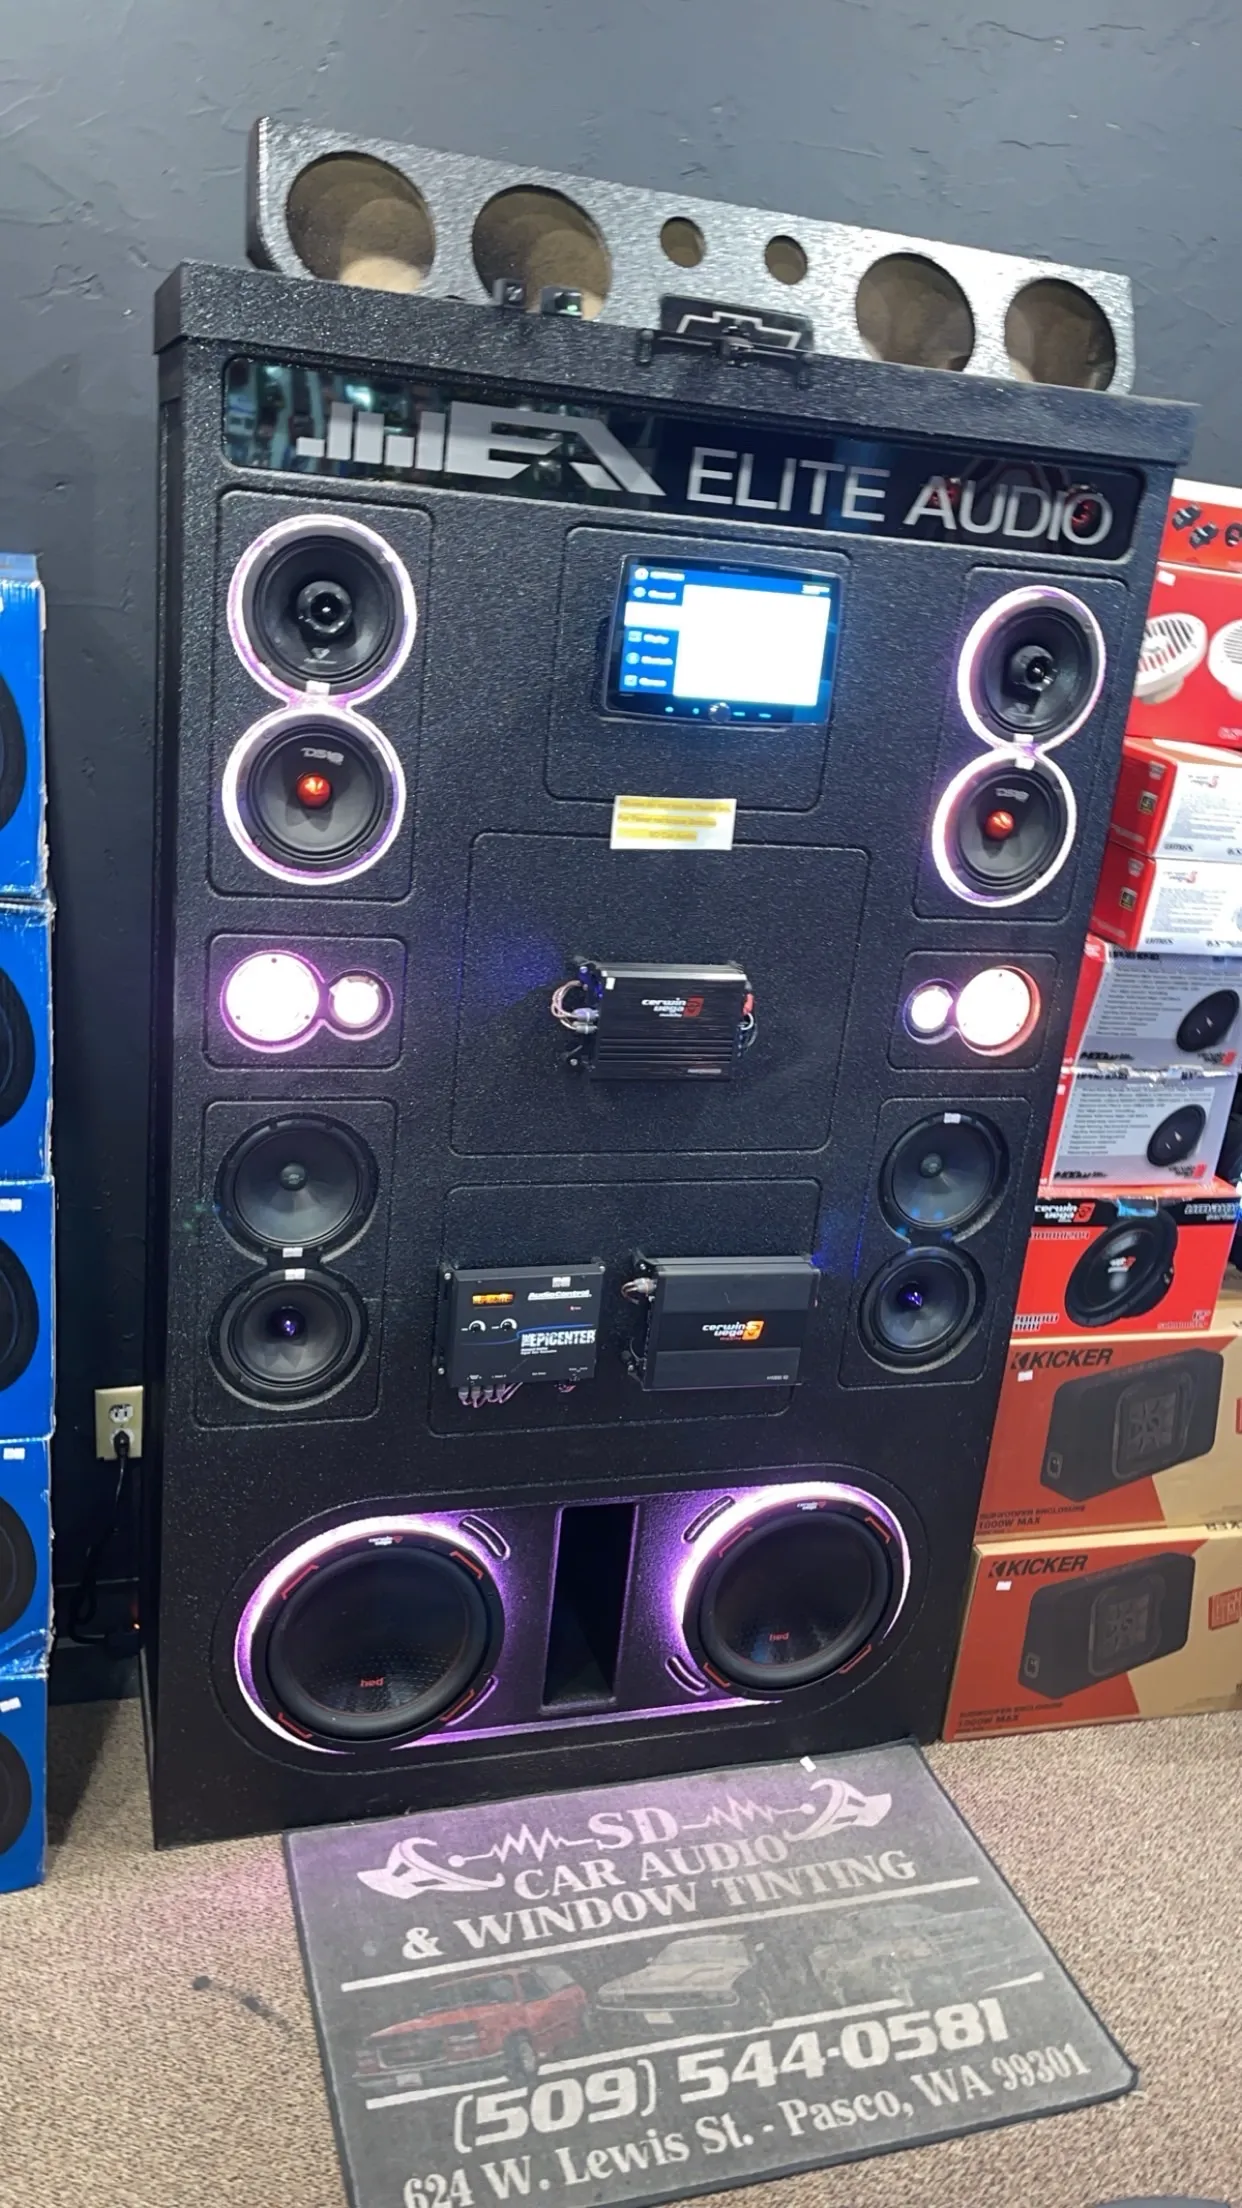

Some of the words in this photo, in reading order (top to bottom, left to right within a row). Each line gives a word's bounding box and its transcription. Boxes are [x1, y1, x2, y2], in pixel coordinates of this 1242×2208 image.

[687, 447, 890, 522] ELITE
[902, 475, 1113, 545] AUDIO
[531, 1329, 597, 1347] EPICENTER
[1028, 1347, 1114, 1370] KICKER
[1006, 1554, 1088, 1577] KICKER
[588, 1807, 678, 1851] SD
[513, 1858, 627, 1900] CAR
[640, 1834, 788, 1882] AUDIO
[402, 1927, 444, 1960] &
[453, 1882, 697, 1950] WINDOW
[712, 1850, 917, 1907] TINTING
[453, 2058, 657, 2154] (509)
[677, 1998, 1010, 2104] 544-0581
[403, 2168, 475, 2208] 624
[480, 2155, 550, 2200] W.
[555, 2128, 690, 2186] Lewis
[695, 2111, 754, 2155] St.
[778, 2089, 914, 2137] Pasco,
[910, 2064, 995, 2108] WA
[991, 2042, 1092, 2092] 99301
